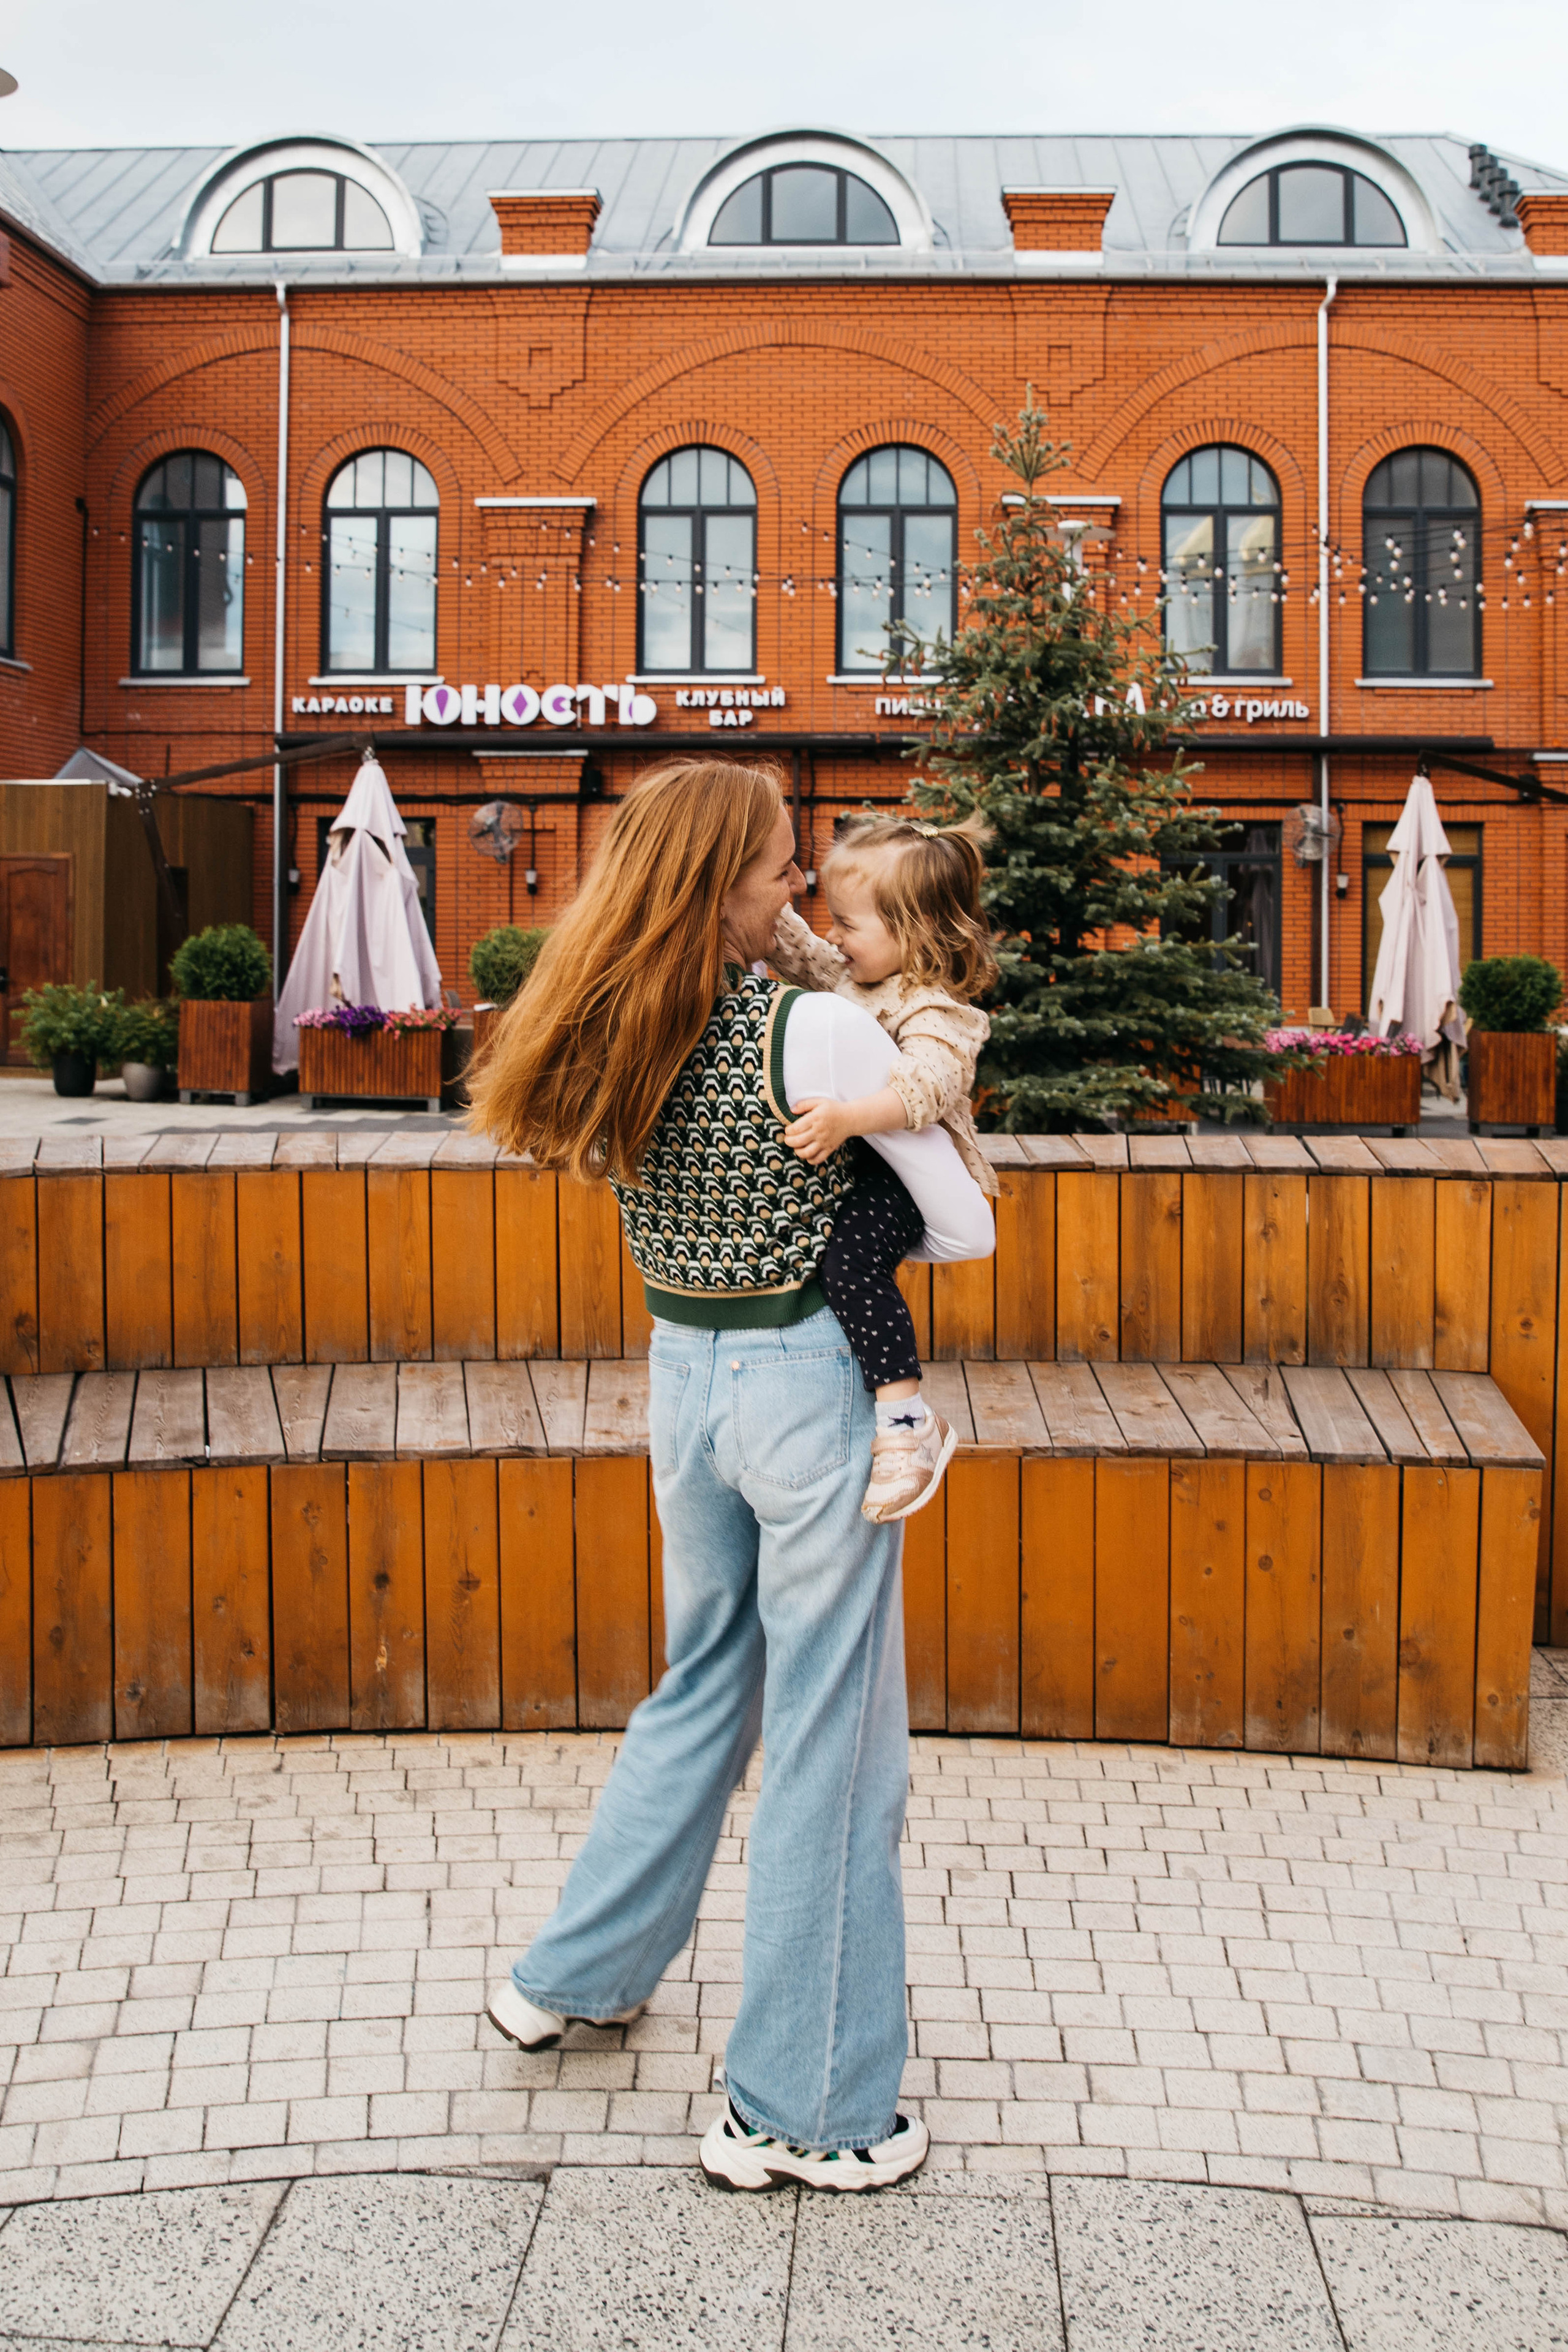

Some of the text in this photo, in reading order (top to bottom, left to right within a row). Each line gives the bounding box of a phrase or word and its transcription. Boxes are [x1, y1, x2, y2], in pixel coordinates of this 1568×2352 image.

[292, 696, 393, 714] КАРАОКЕ
[405, 684, 657, 725] ЮНОСТЬ
[676, 686, 786, 707] КЛУБНЫЙ
[709, 709, 753, 726] БАР
[1211, 693, 1231, 718] &
[1234, 699, 1310, 723] гриль
